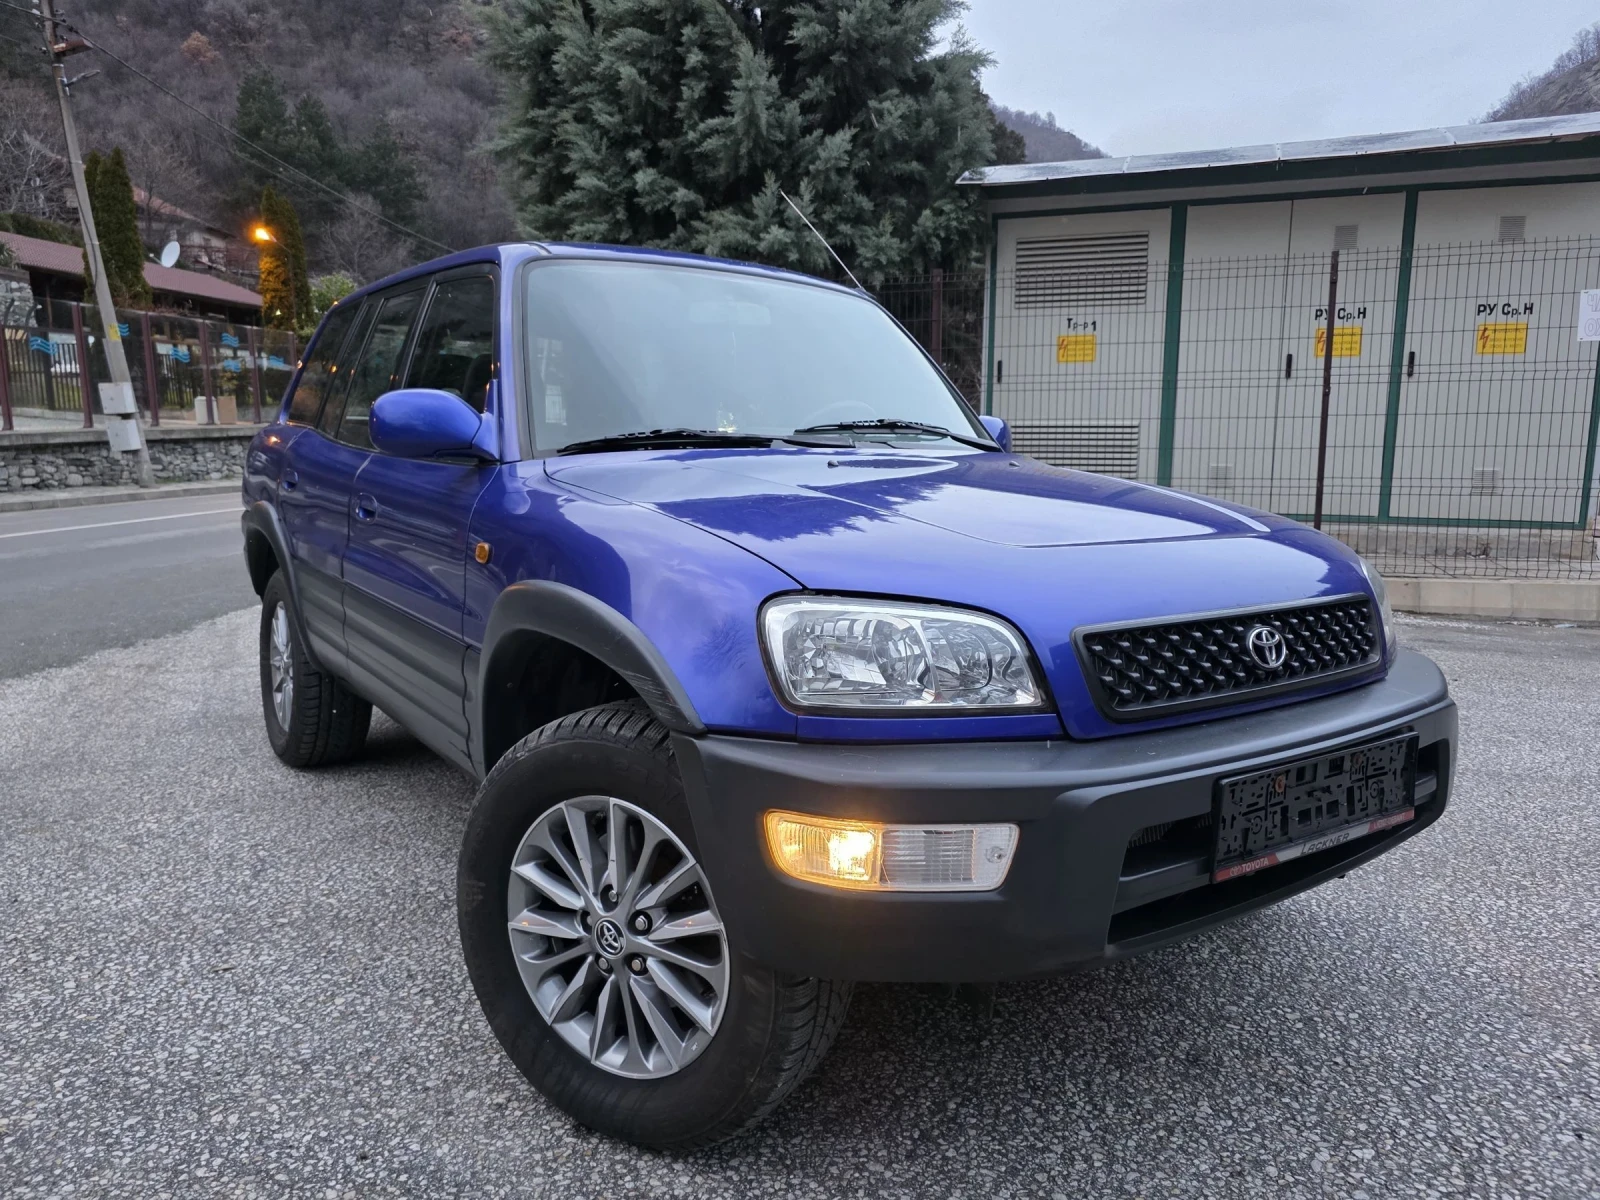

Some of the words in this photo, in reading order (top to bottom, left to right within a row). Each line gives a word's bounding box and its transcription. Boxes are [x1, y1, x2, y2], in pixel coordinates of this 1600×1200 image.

[1477, 303, 1498, 316] РУ
[1091, 320, 1097, 331] 1
[1300, 832, 1349, 856] LACKNER
[1242, 857, 1269, 872] TOYOTA
